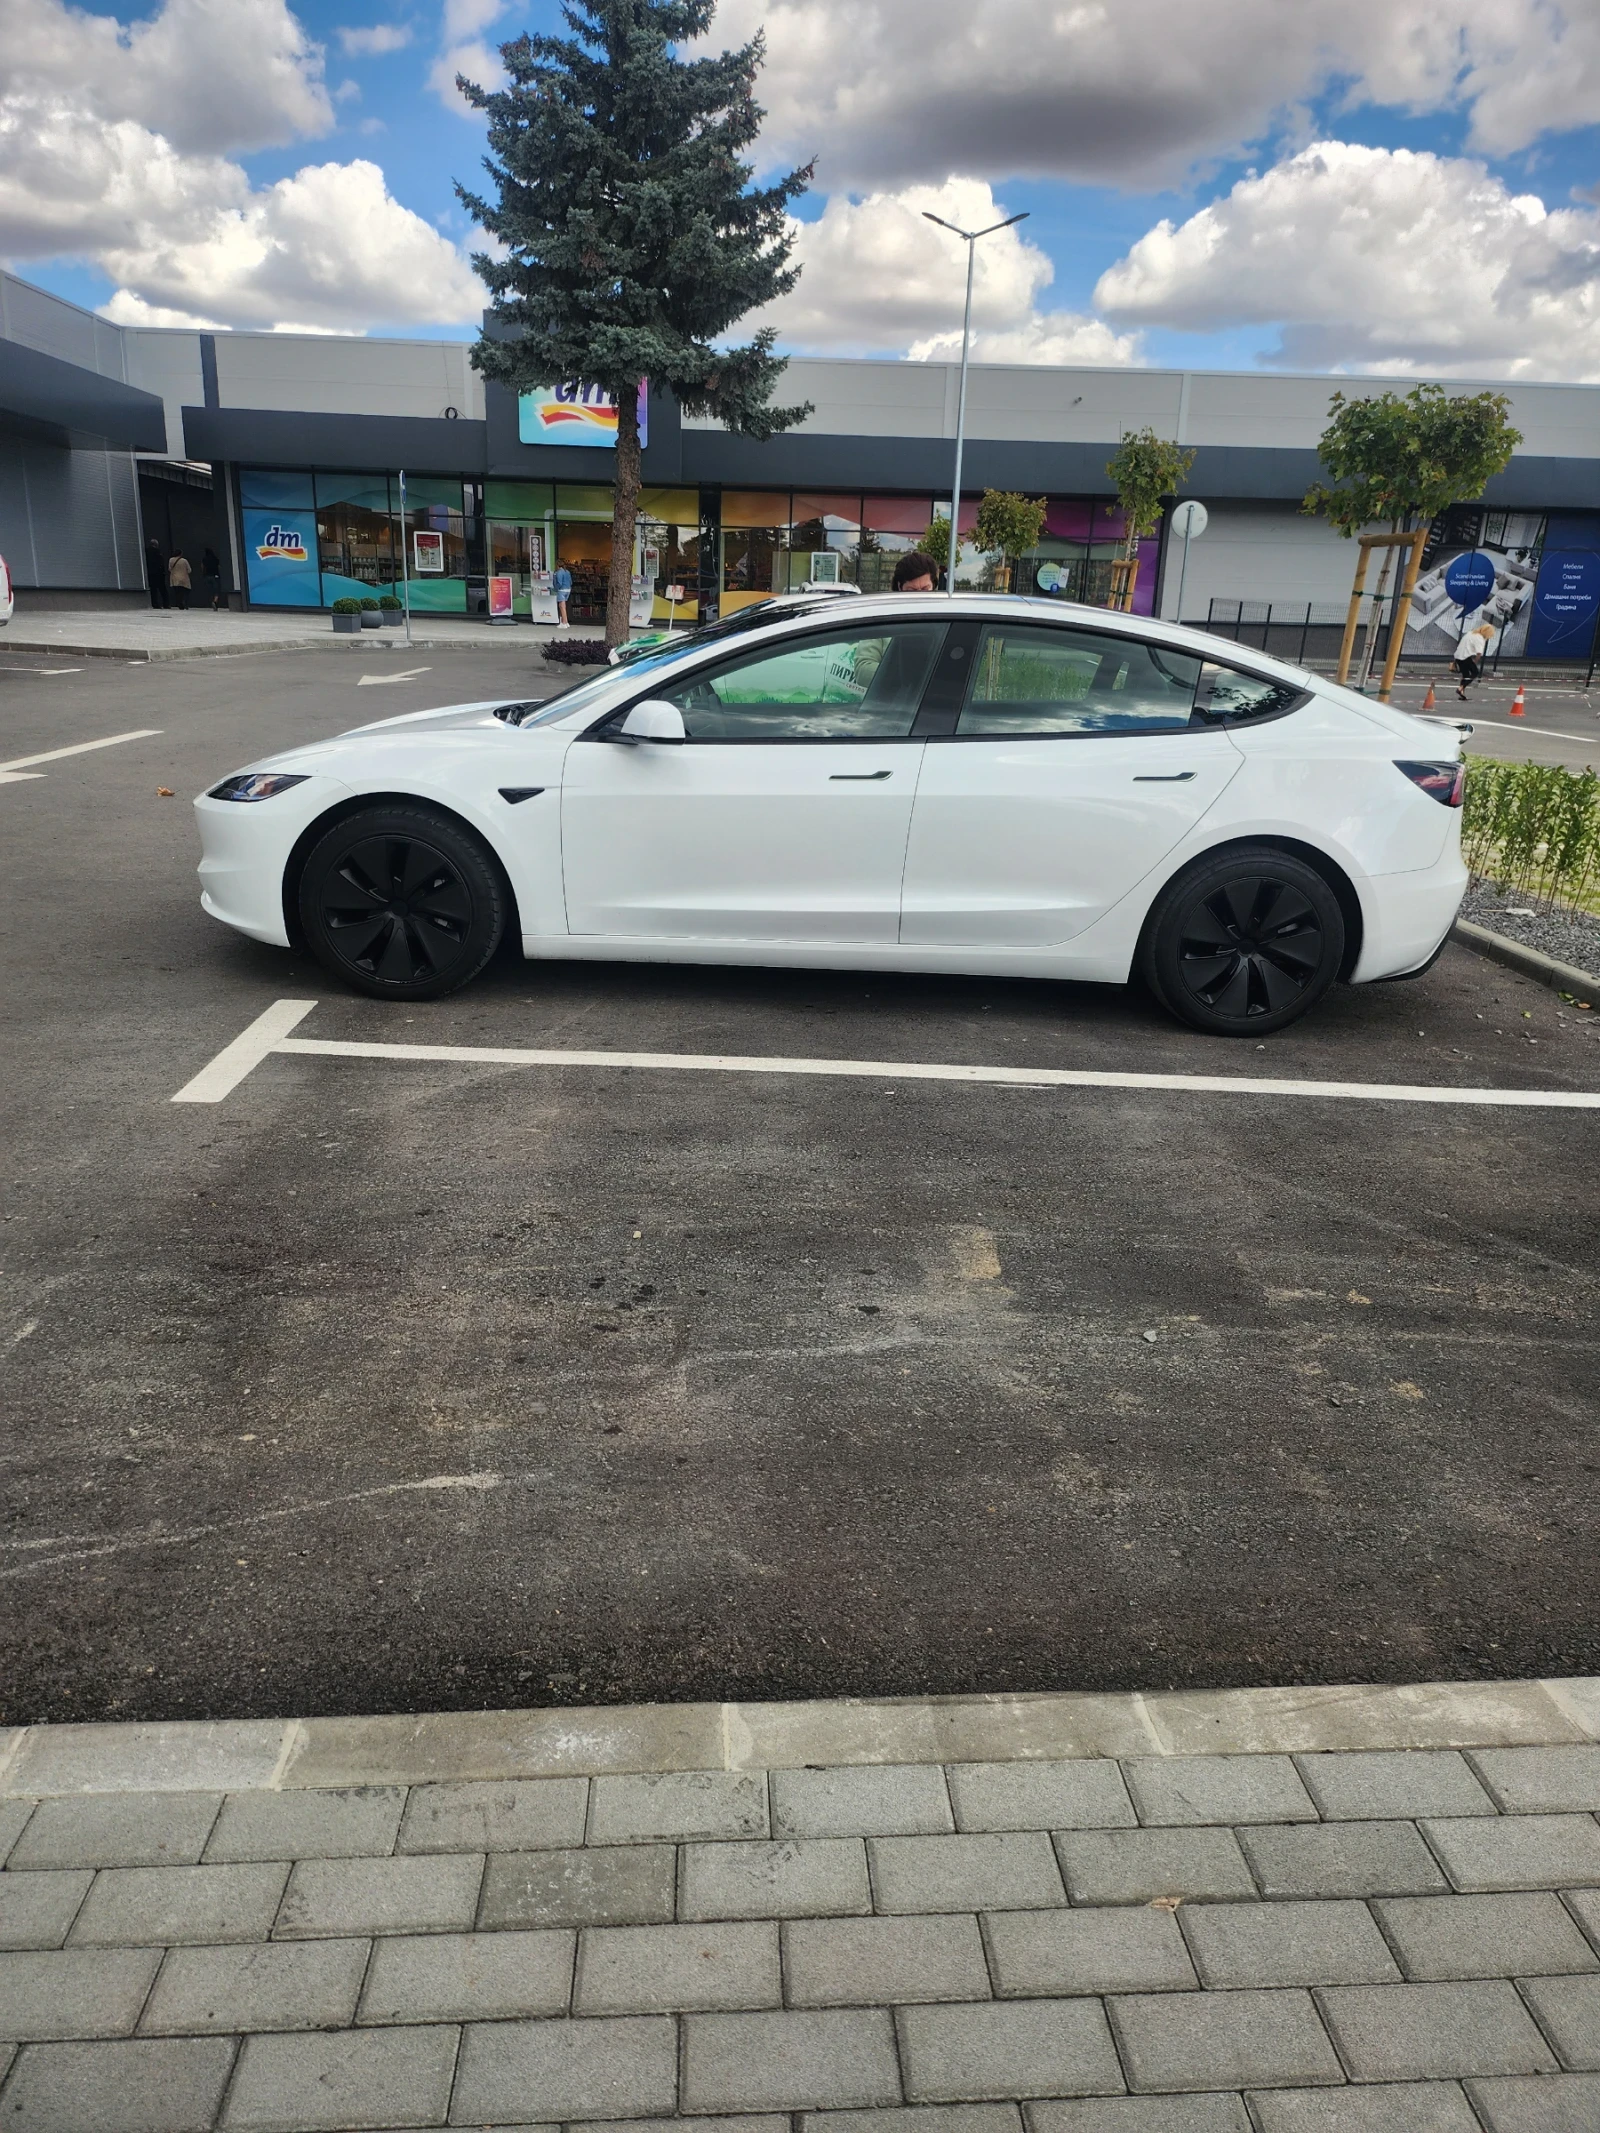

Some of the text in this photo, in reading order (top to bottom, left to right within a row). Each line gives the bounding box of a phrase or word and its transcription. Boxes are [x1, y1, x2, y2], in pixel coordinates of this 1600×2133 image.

[266, 526, 300, 548] dm
[1555, 603, 1577, 611] Градина
[830, 662, 858, 684] ПИРИ
